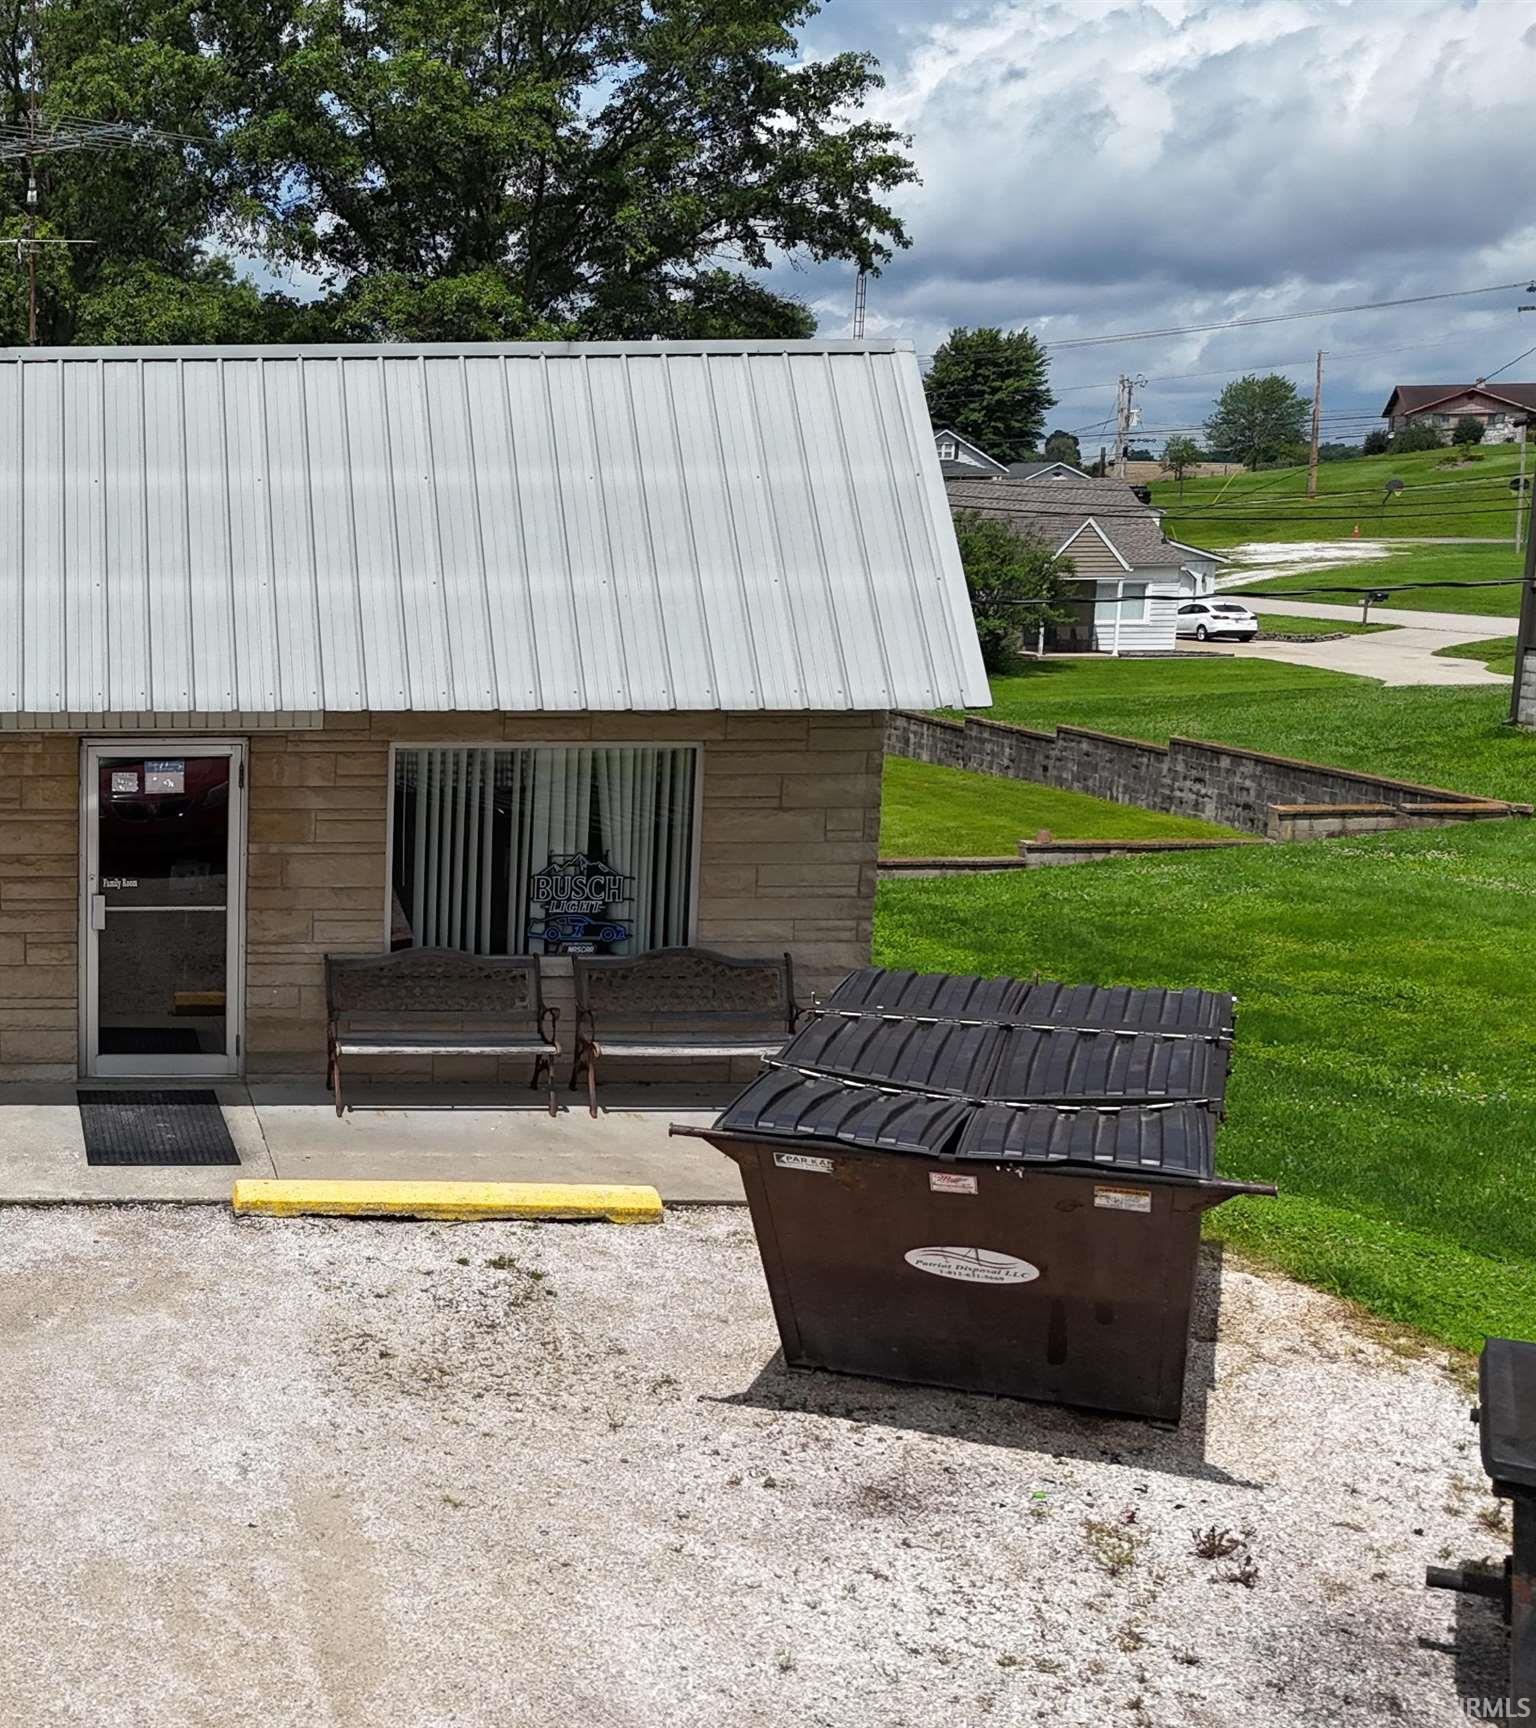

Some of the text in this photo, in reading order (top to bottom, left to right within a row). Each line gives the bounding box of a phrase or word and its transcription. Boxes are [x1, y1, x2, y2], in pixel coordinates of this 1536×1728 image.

[102, 878, 122, 890] Family
[533, 875, 624, 902] BUSCH
[549, 900, 603, 913] LIGHT
[915, 1259, 952, 1270] Patriot
[955, 1263, 1003, 1276] Disposal
